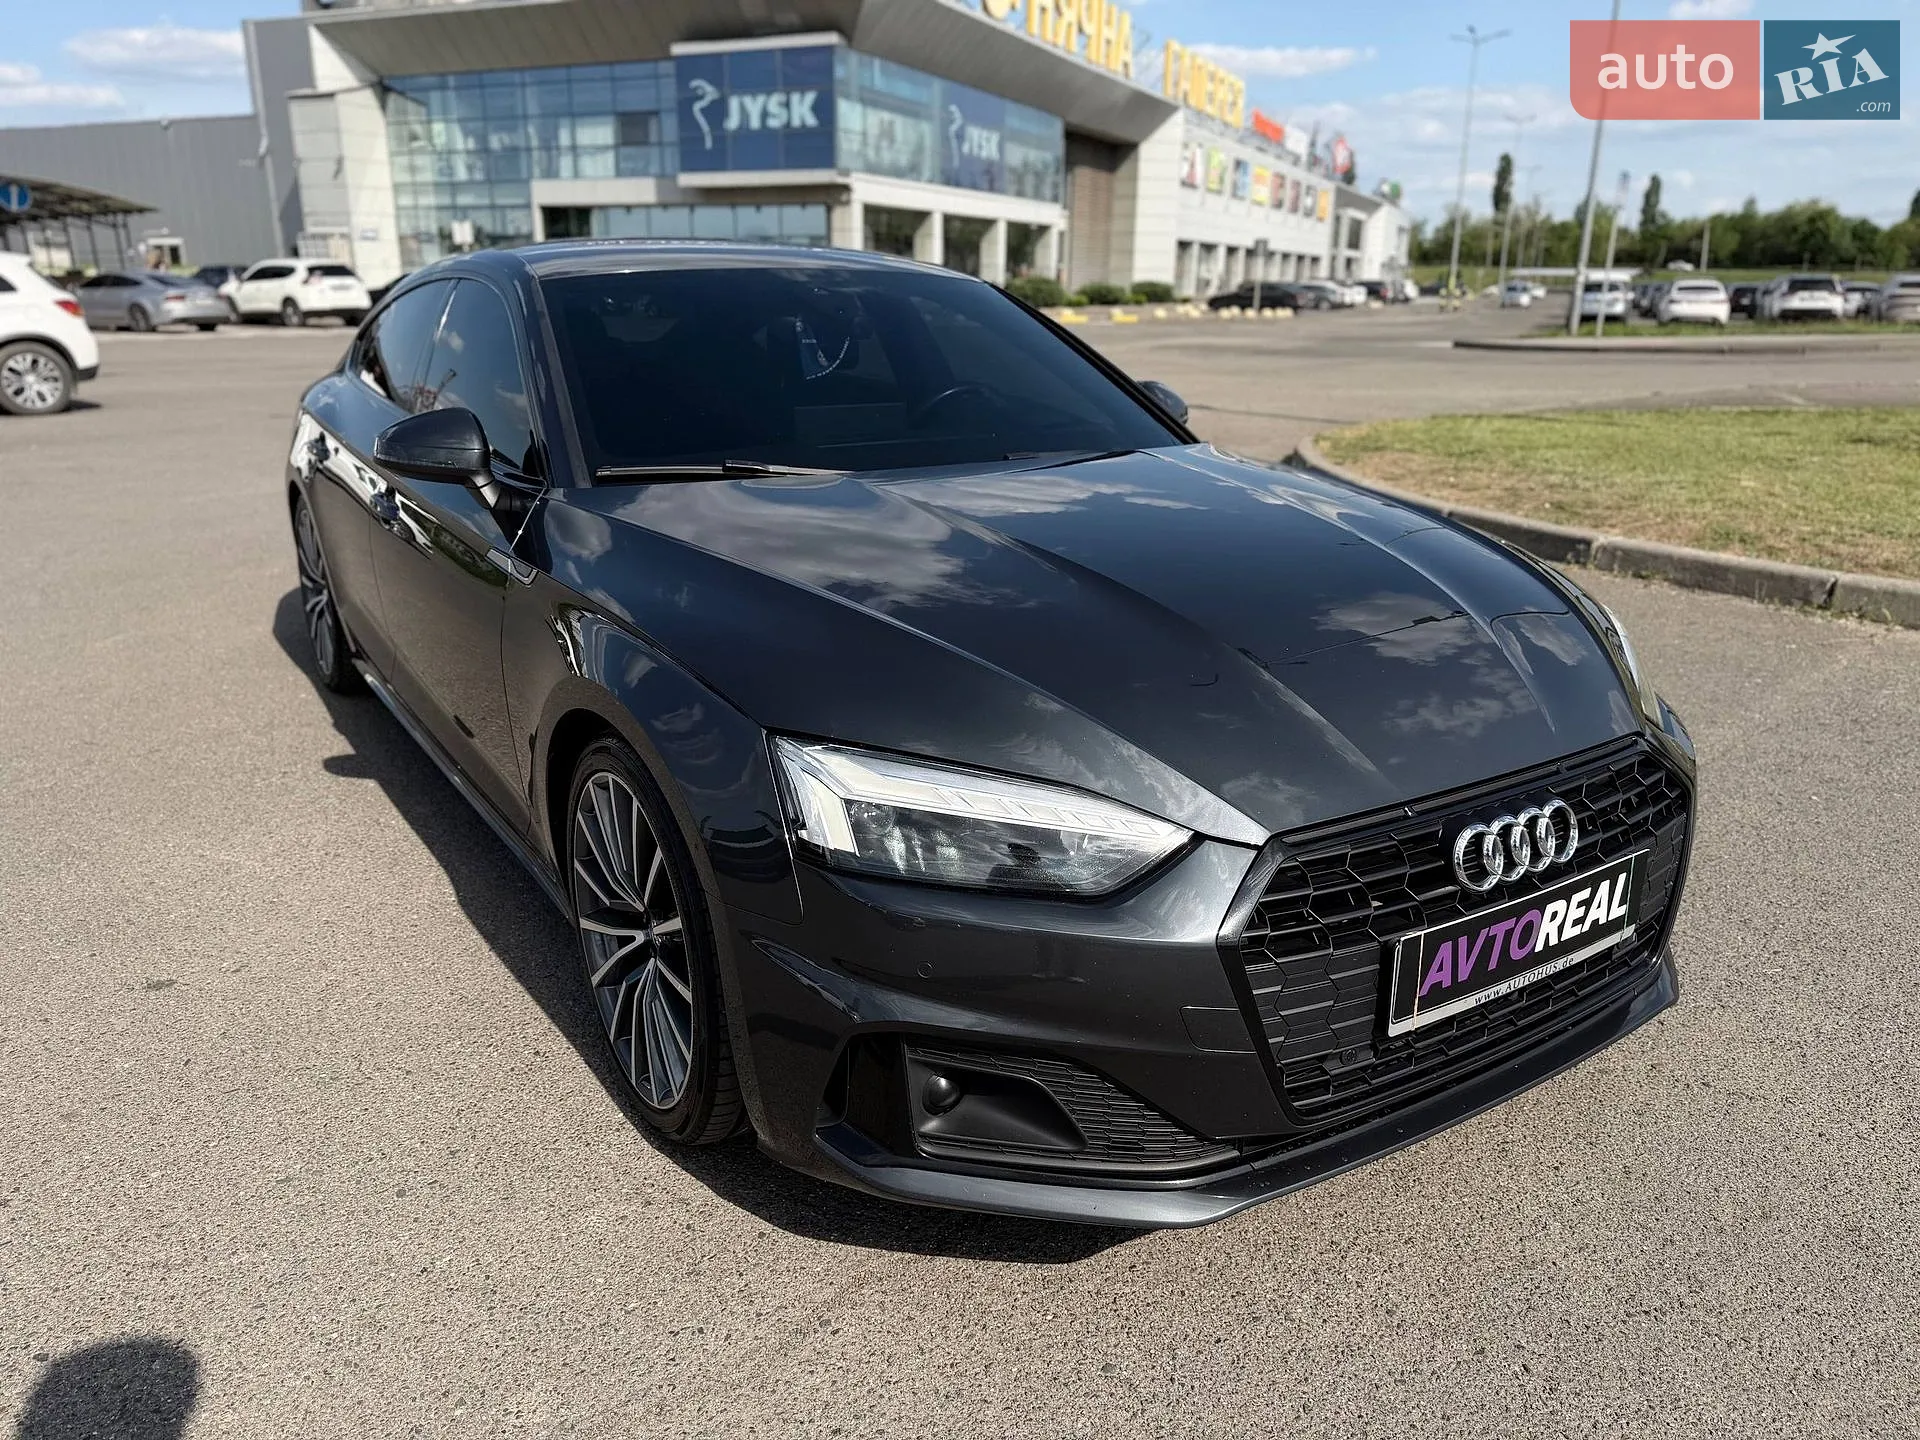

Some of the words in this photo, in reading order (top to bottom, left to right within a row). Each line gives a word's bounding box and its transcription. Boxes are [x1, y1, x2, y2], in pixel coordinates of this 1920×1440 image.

[982, 0, 1132, 80] НЯЧНА
[723, 91, 819, 130] JYSK
[961, 126, 1000, 161] JYSK
[1418, 871, 1628, 998] AVTOREAL
[1473, 956, 1575, 1006] www.AUTOHUS.de
